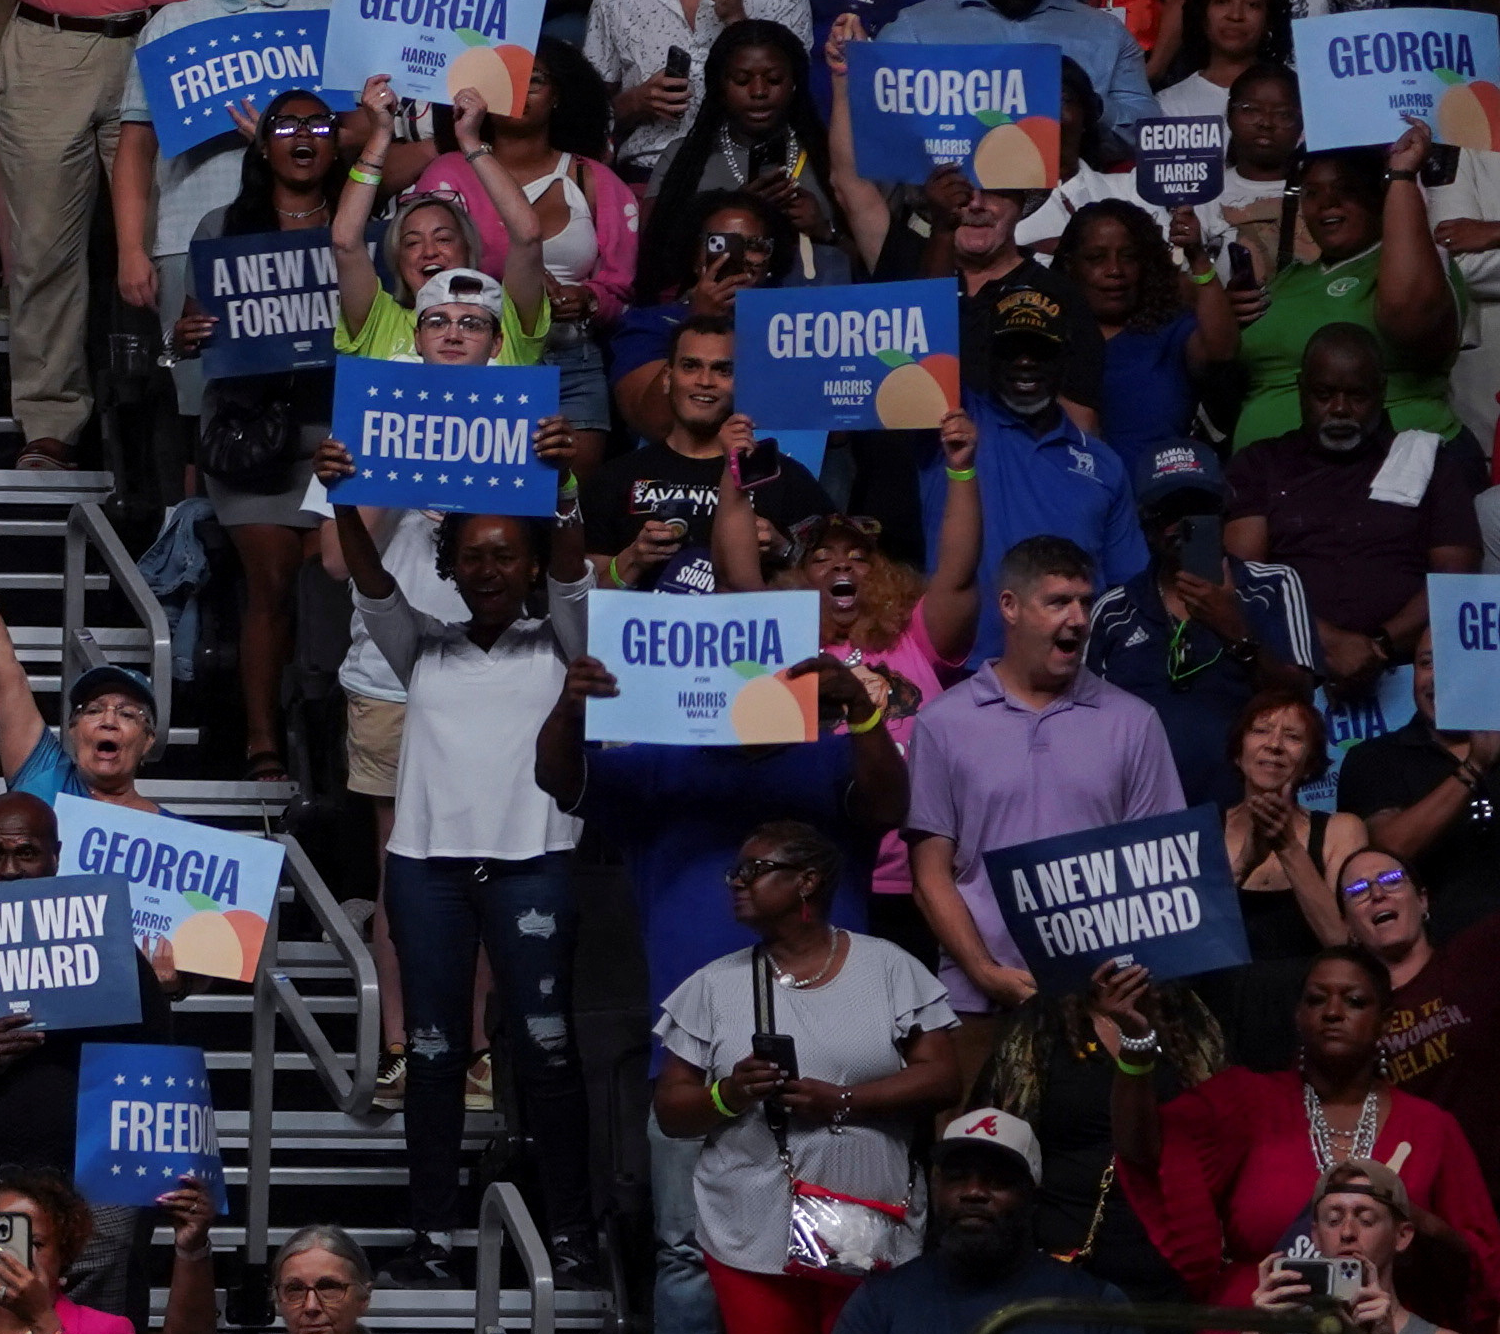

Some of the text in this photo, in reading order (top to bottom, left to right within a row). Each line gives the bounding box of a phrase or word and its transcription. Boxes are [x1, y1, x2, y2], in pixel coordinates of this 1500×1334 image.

[169, 44, 319, 110] FREEDOM
[1329, 31, 1476, 77] GEORGIA
[1140, 123, 1221, 151] GEORGIA
[1154, 163, 1208, 184] HARRIS
[1163, 180, 1200, 194] WALZ
[768, 306, 929, 359] GEORGIA
[823, 380, 872, 399] HARRIS
[831, 395, 864, 405] WALZ
[362, 410, 528, 464] FREEDOM
[80, 830, 239, 904] GEORGIA
[1012, 832, 1200, 913] A NEW WAY
[1039, 886, 1201, 957] FORWARD
